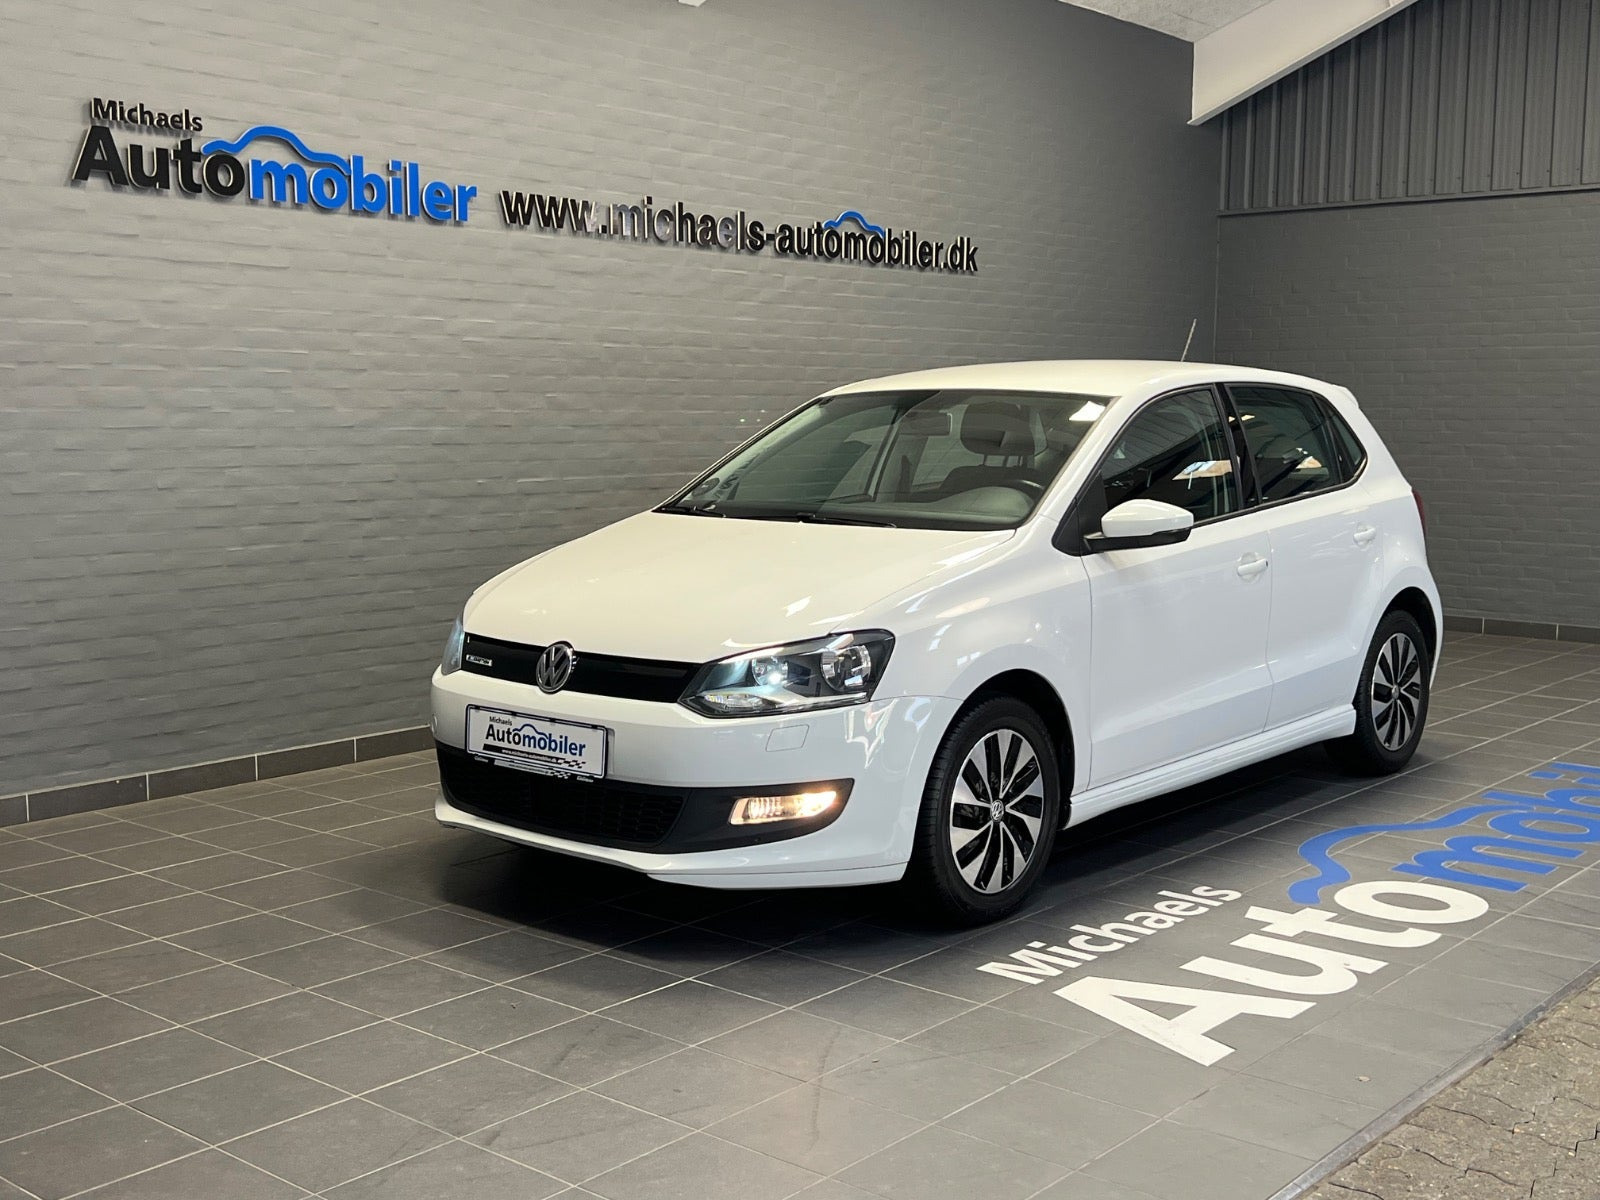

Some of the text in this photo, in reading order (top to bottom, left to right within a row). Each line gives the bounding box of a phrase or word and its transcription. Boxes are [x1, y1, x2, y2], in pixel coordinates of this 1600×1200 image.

[91, 97, 203, 132] Michaels
[71, 125, 477, 222] Automobiler
[499, 189, 979, 272] www.michaels-automobiler.dk
[485, 723, 586, 757] Automobiler
[489, 716, 513, 727] Michaels
[977, 881, 1243, 985] Michaels
